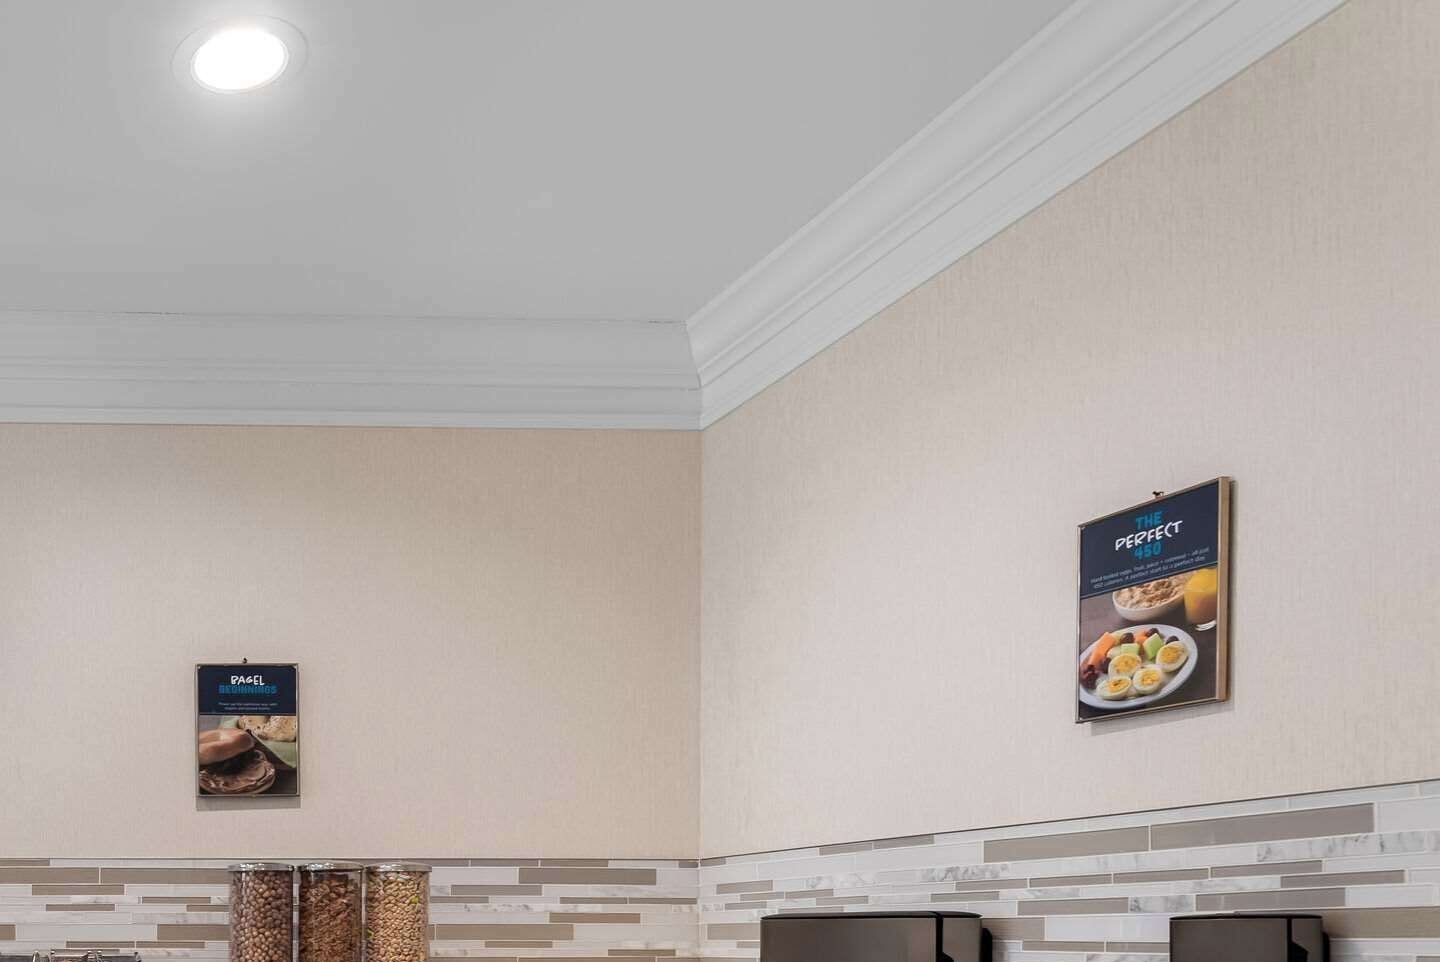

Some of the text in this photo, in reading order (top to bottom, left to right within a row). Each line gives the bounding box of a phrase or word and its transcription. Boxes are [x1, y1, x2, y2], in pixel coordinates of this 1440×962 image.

[1136, 511, 1163, 529] THE
[1115, 520, 1183, 551] PERFECT
[1134, 541, 1162, 559] 450
[230, 675, 265, 686] BAGEL
